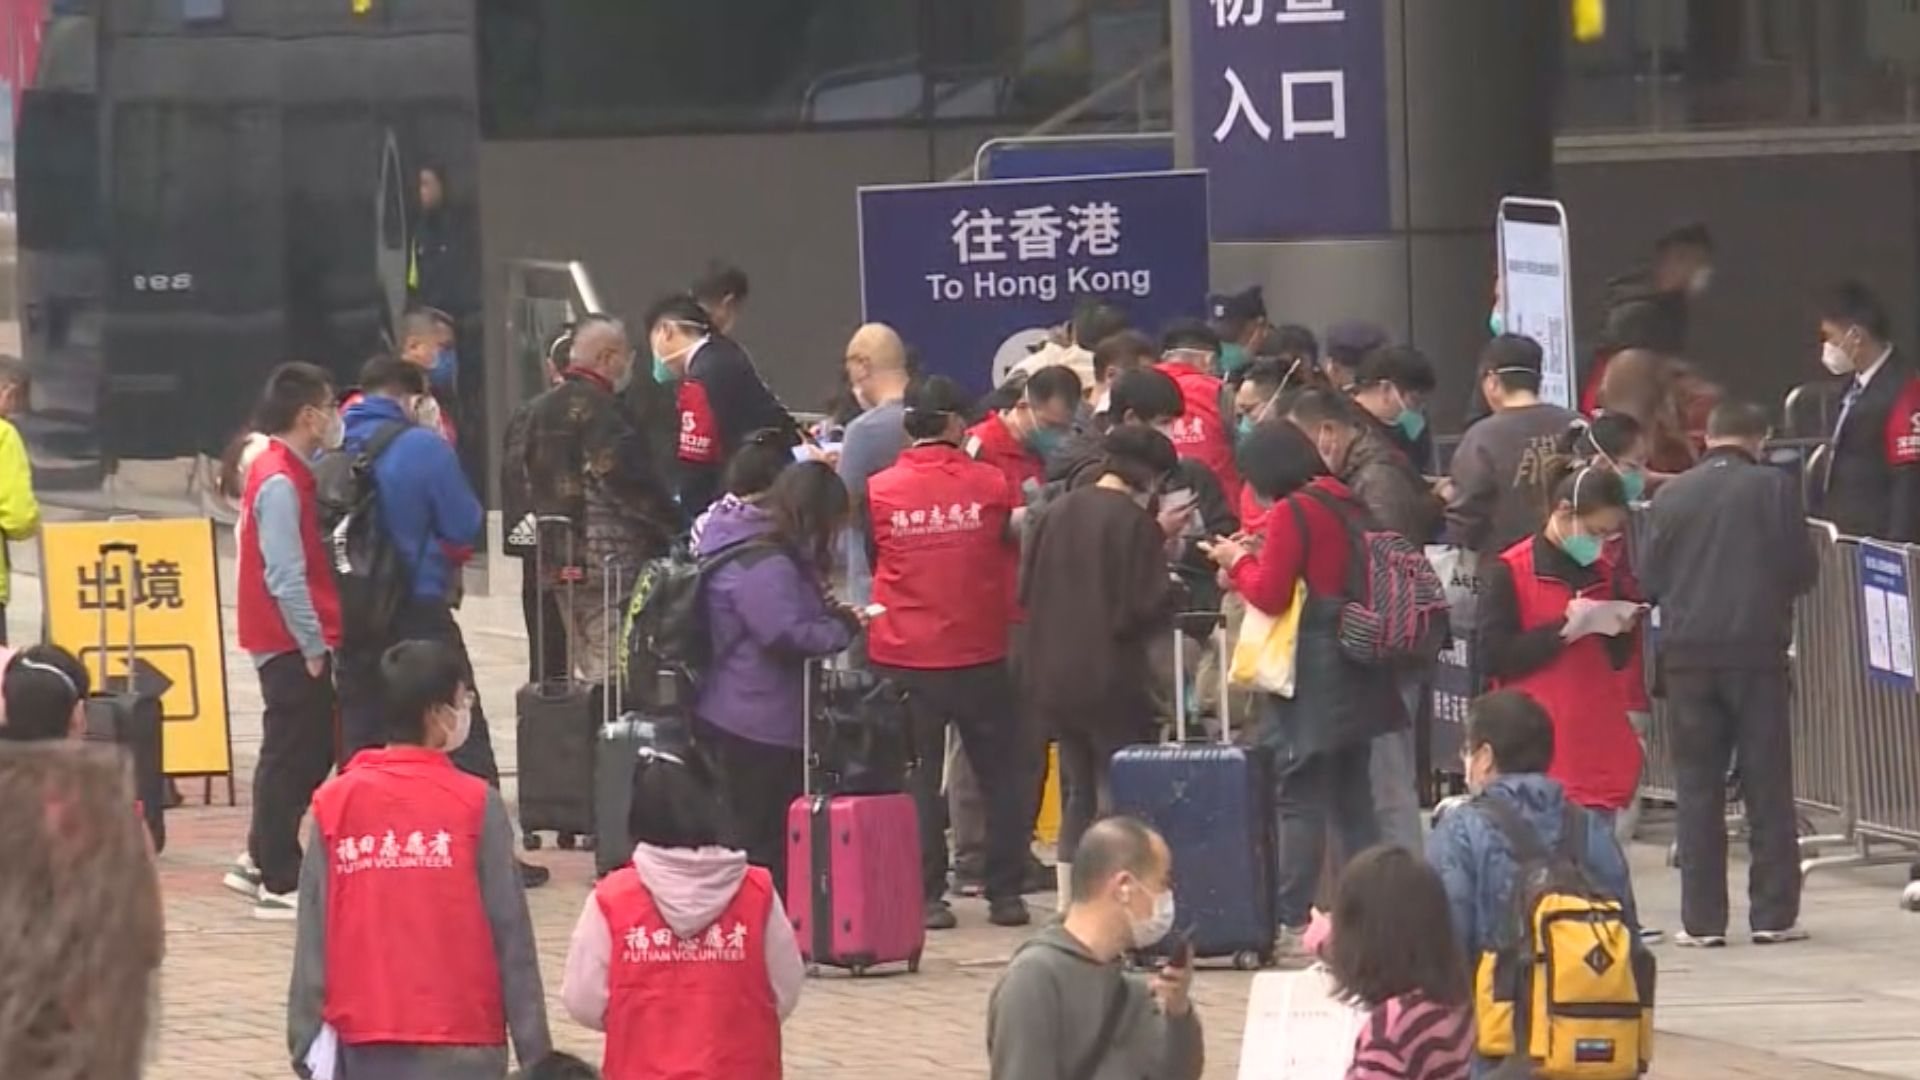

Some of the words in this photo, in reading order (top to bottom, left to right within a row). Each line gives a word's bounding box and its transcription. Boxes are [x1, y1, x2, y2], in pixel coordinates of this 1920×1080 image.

[1213, 66, 1346, 143] 入口
[951, 201, 1121, 264] 往香港
[925, 274, 964, 300] To
[974, 271, 1057, 301] Hong
[1067, 266, 1150, 296] Kong
[78, 559, 184, 610] 出境
[336, 828, 452, 863] 福田志愿者
